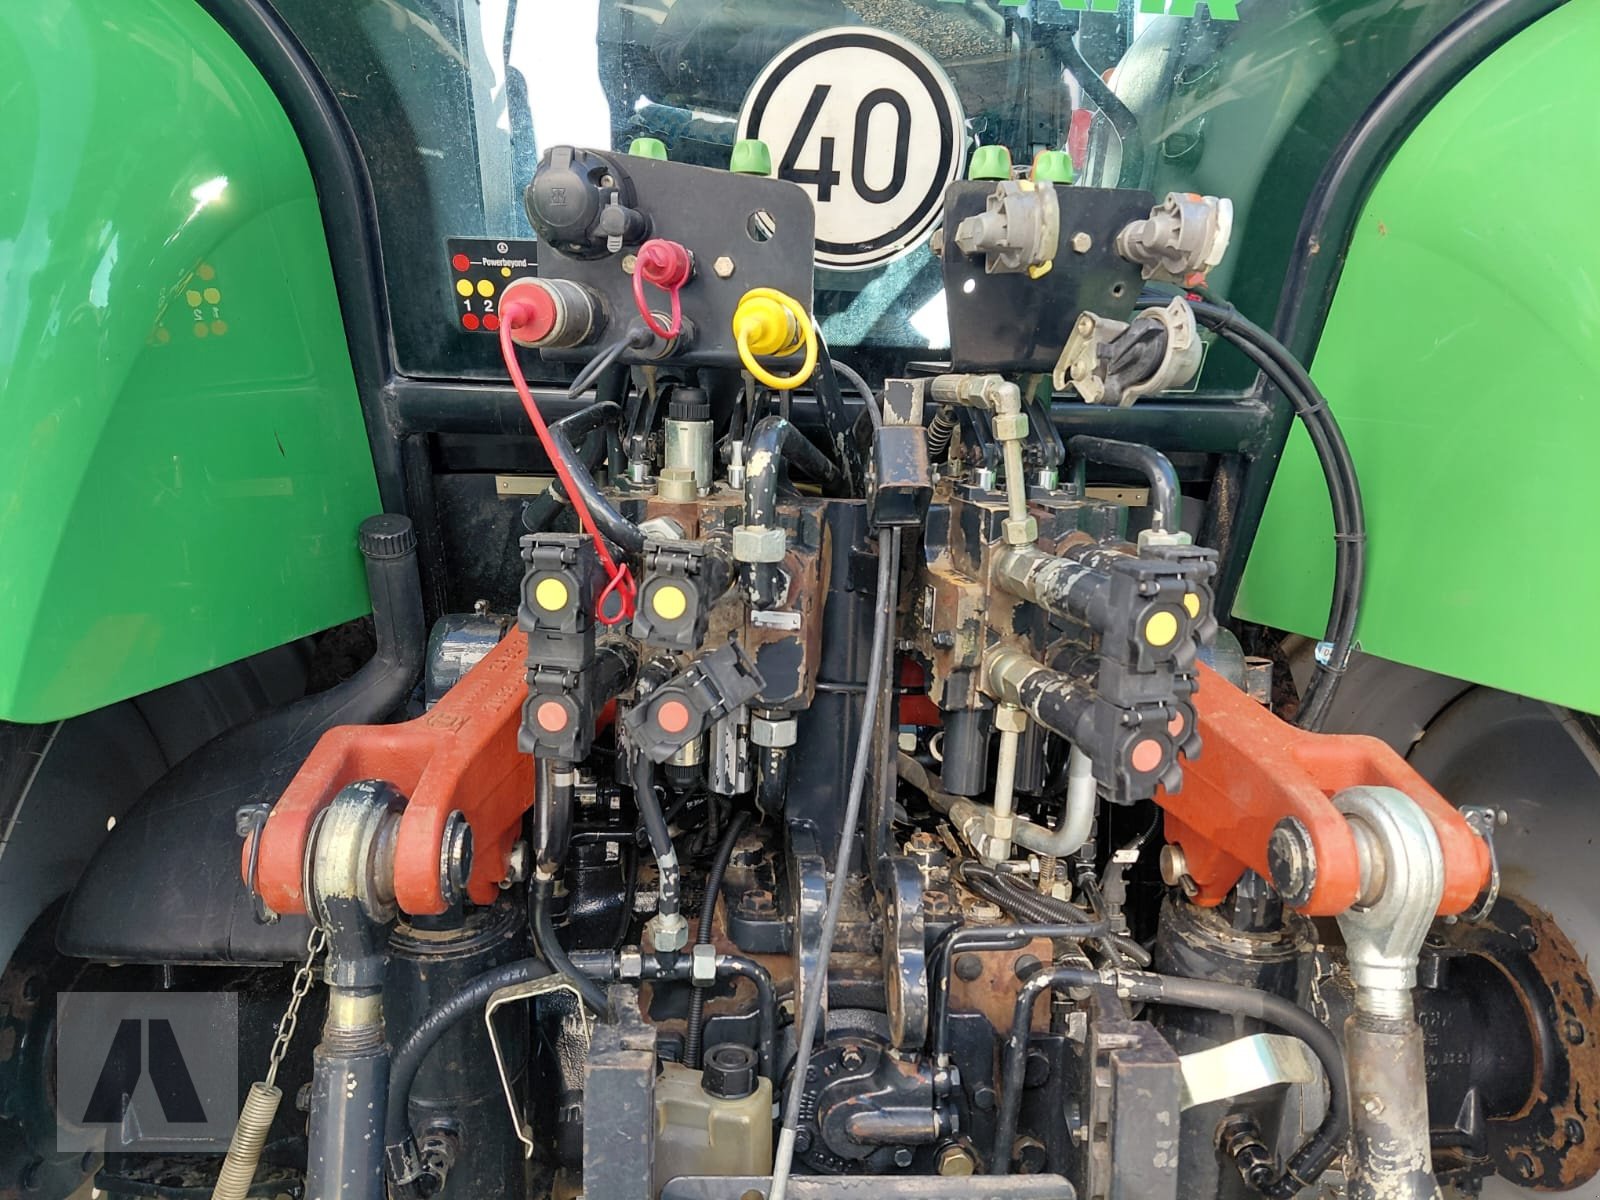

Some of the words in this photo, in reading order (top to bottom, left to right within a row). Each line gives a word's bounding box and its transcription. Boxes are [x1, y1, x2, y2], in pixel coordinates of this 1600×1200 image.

[778, 84, 912, 204] 40
[482, 257, 527, 269] Powerbeyond
[463, 299, 472, 312] 1
[483, 299, 494, 312] 2
